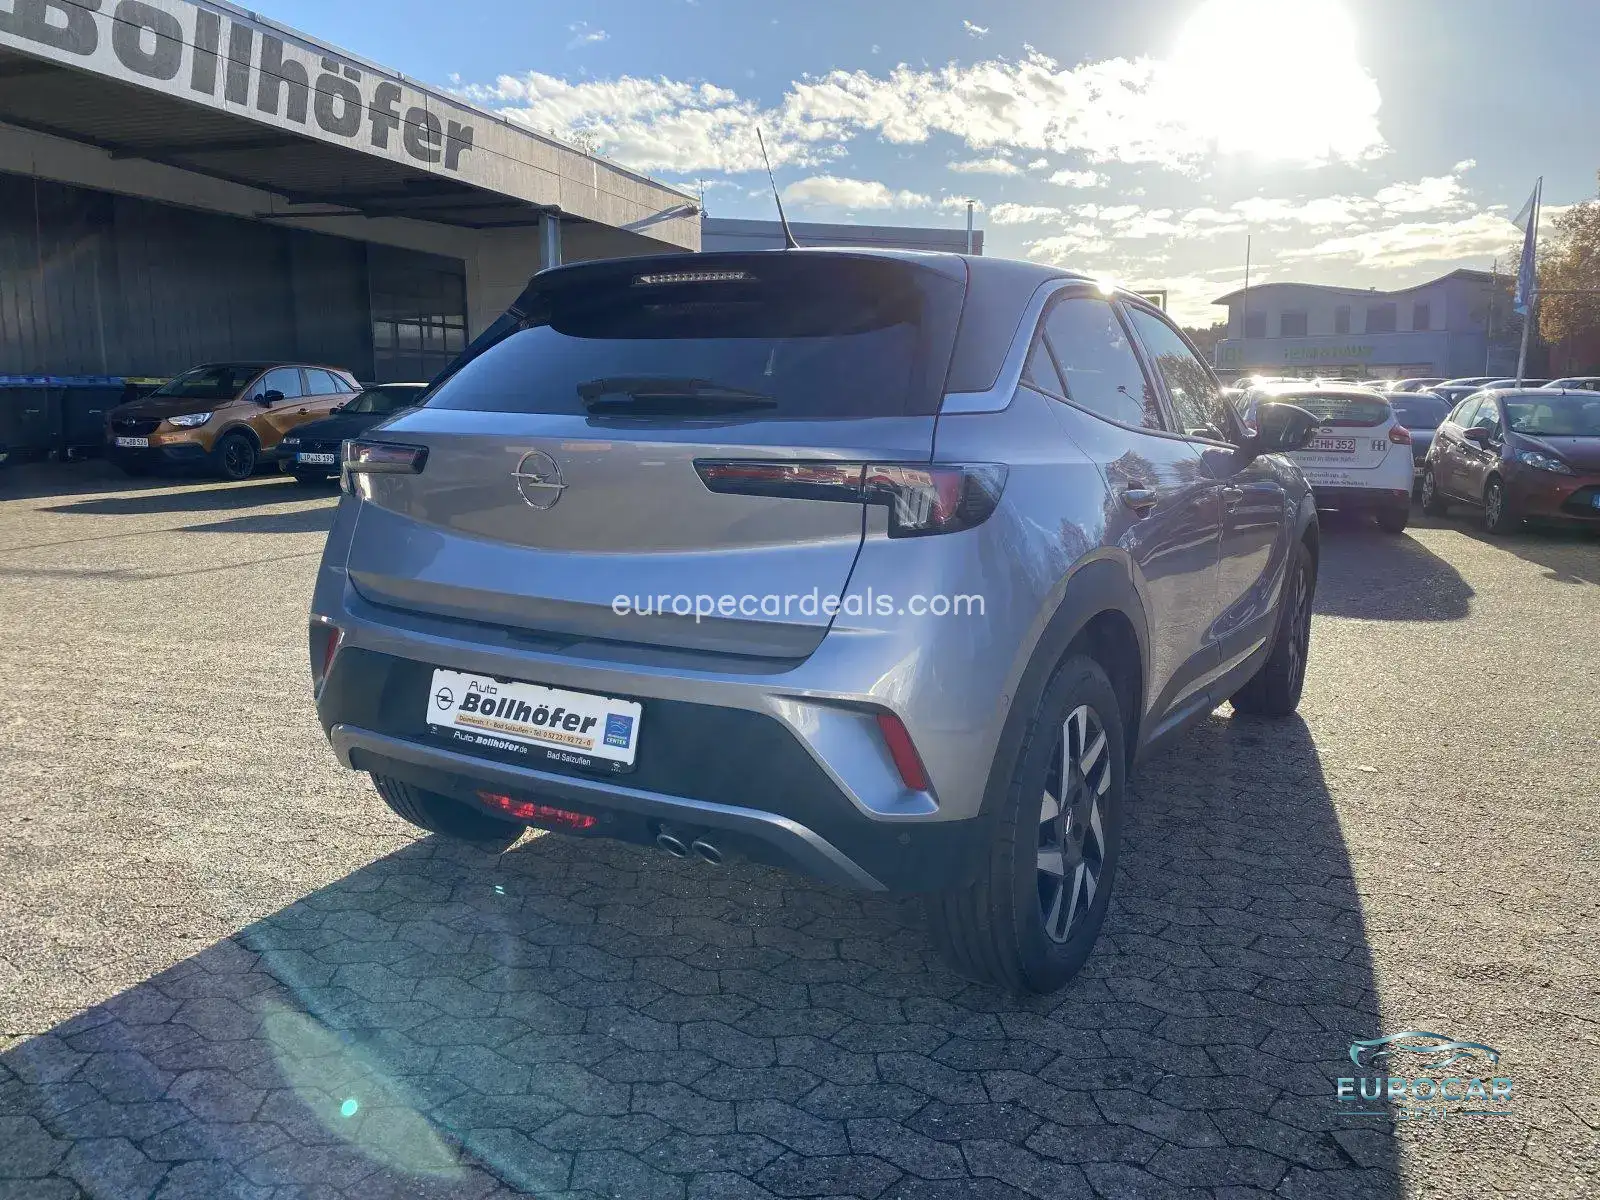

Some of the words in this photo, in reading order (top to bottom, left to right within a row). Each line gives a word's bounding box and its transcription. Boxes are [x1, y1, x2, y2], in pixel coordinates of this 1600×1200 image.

[0, 0, 474, 172] Bollhöfer
[1320, 441, 1334, 449] HH
[1335, 440, 1354, 450] 352
[323, 454, 334, 463] 195
[468, 680, 498, 695] Auto
[459, 692, 598, 734] Bollhöfer
[546, 750, 560, 761] Bad
[561, 752, 591, 766] Salzuflen
